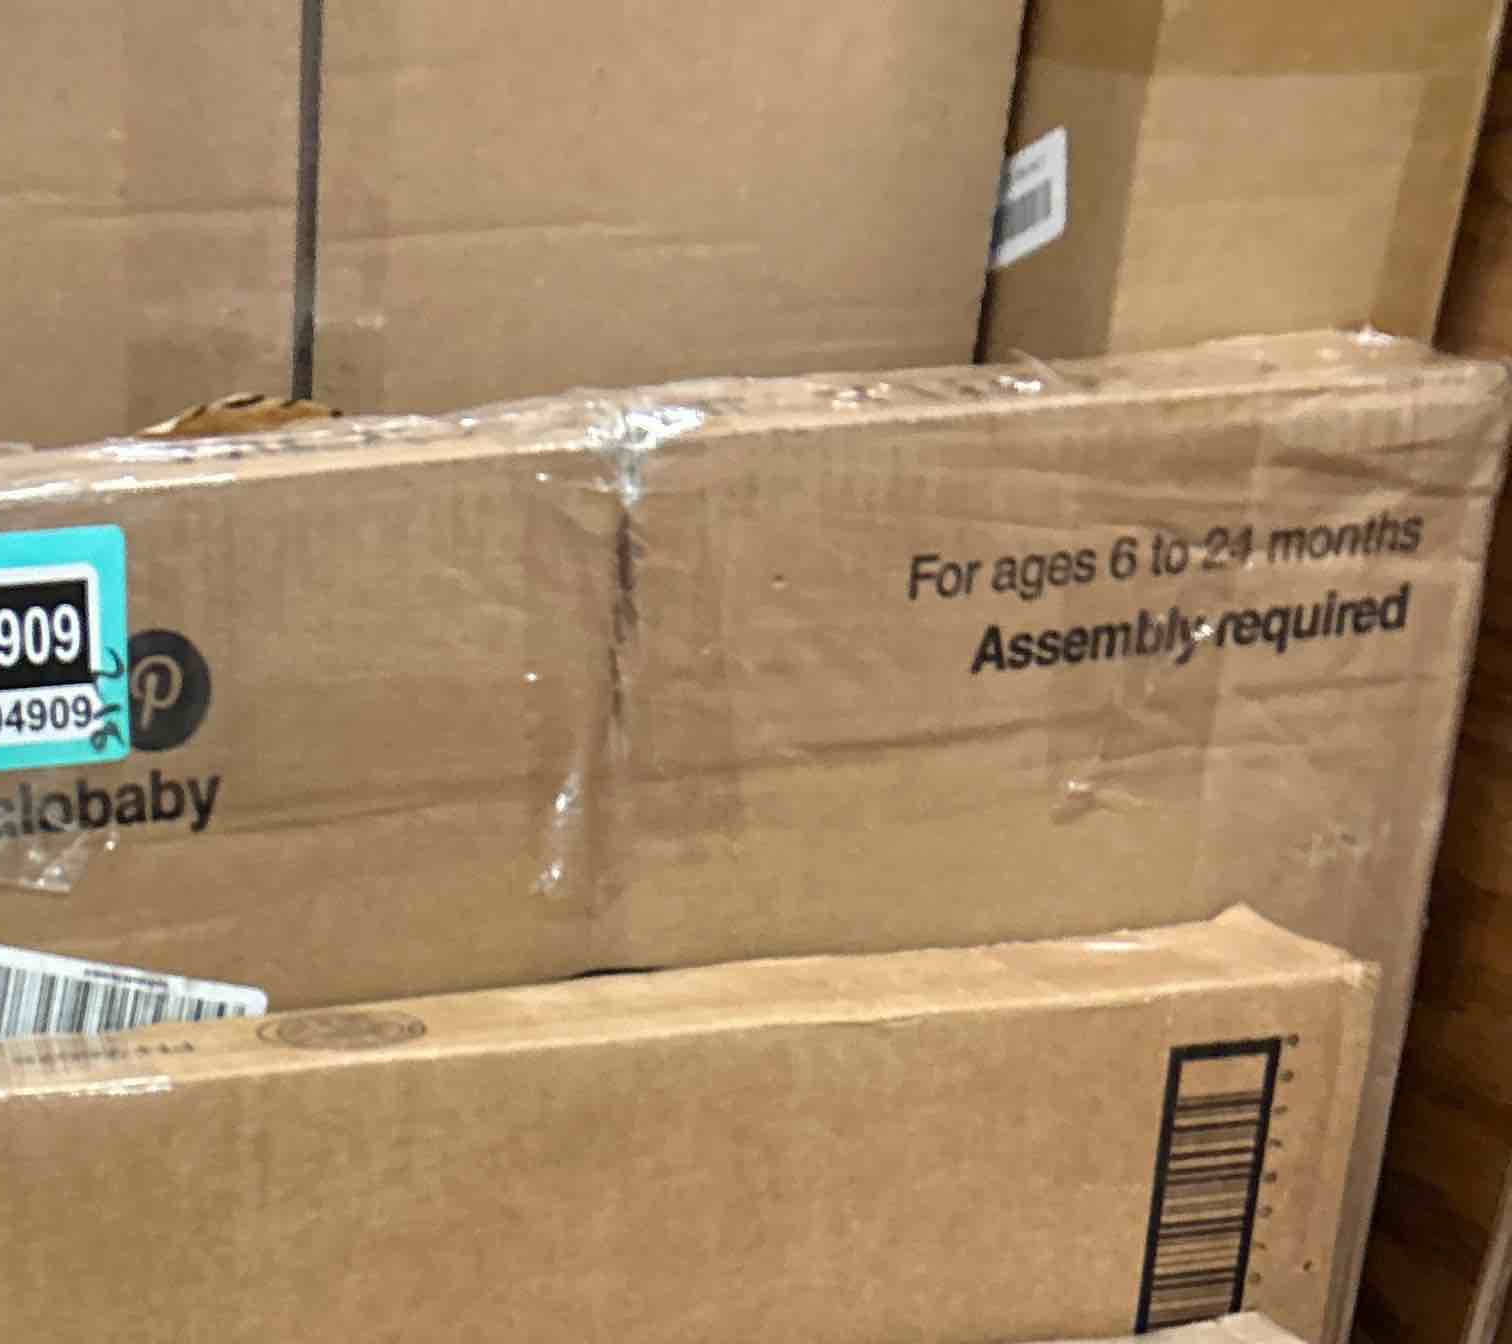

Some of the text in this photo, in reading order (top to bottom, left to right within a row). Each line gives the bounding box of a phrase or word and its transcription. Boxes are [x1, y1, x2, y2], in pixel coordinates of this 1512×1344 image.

[908, 512, 1424, 600] For ages 6 to 24 months
[971, 583, 1412, 674] Assembly required
